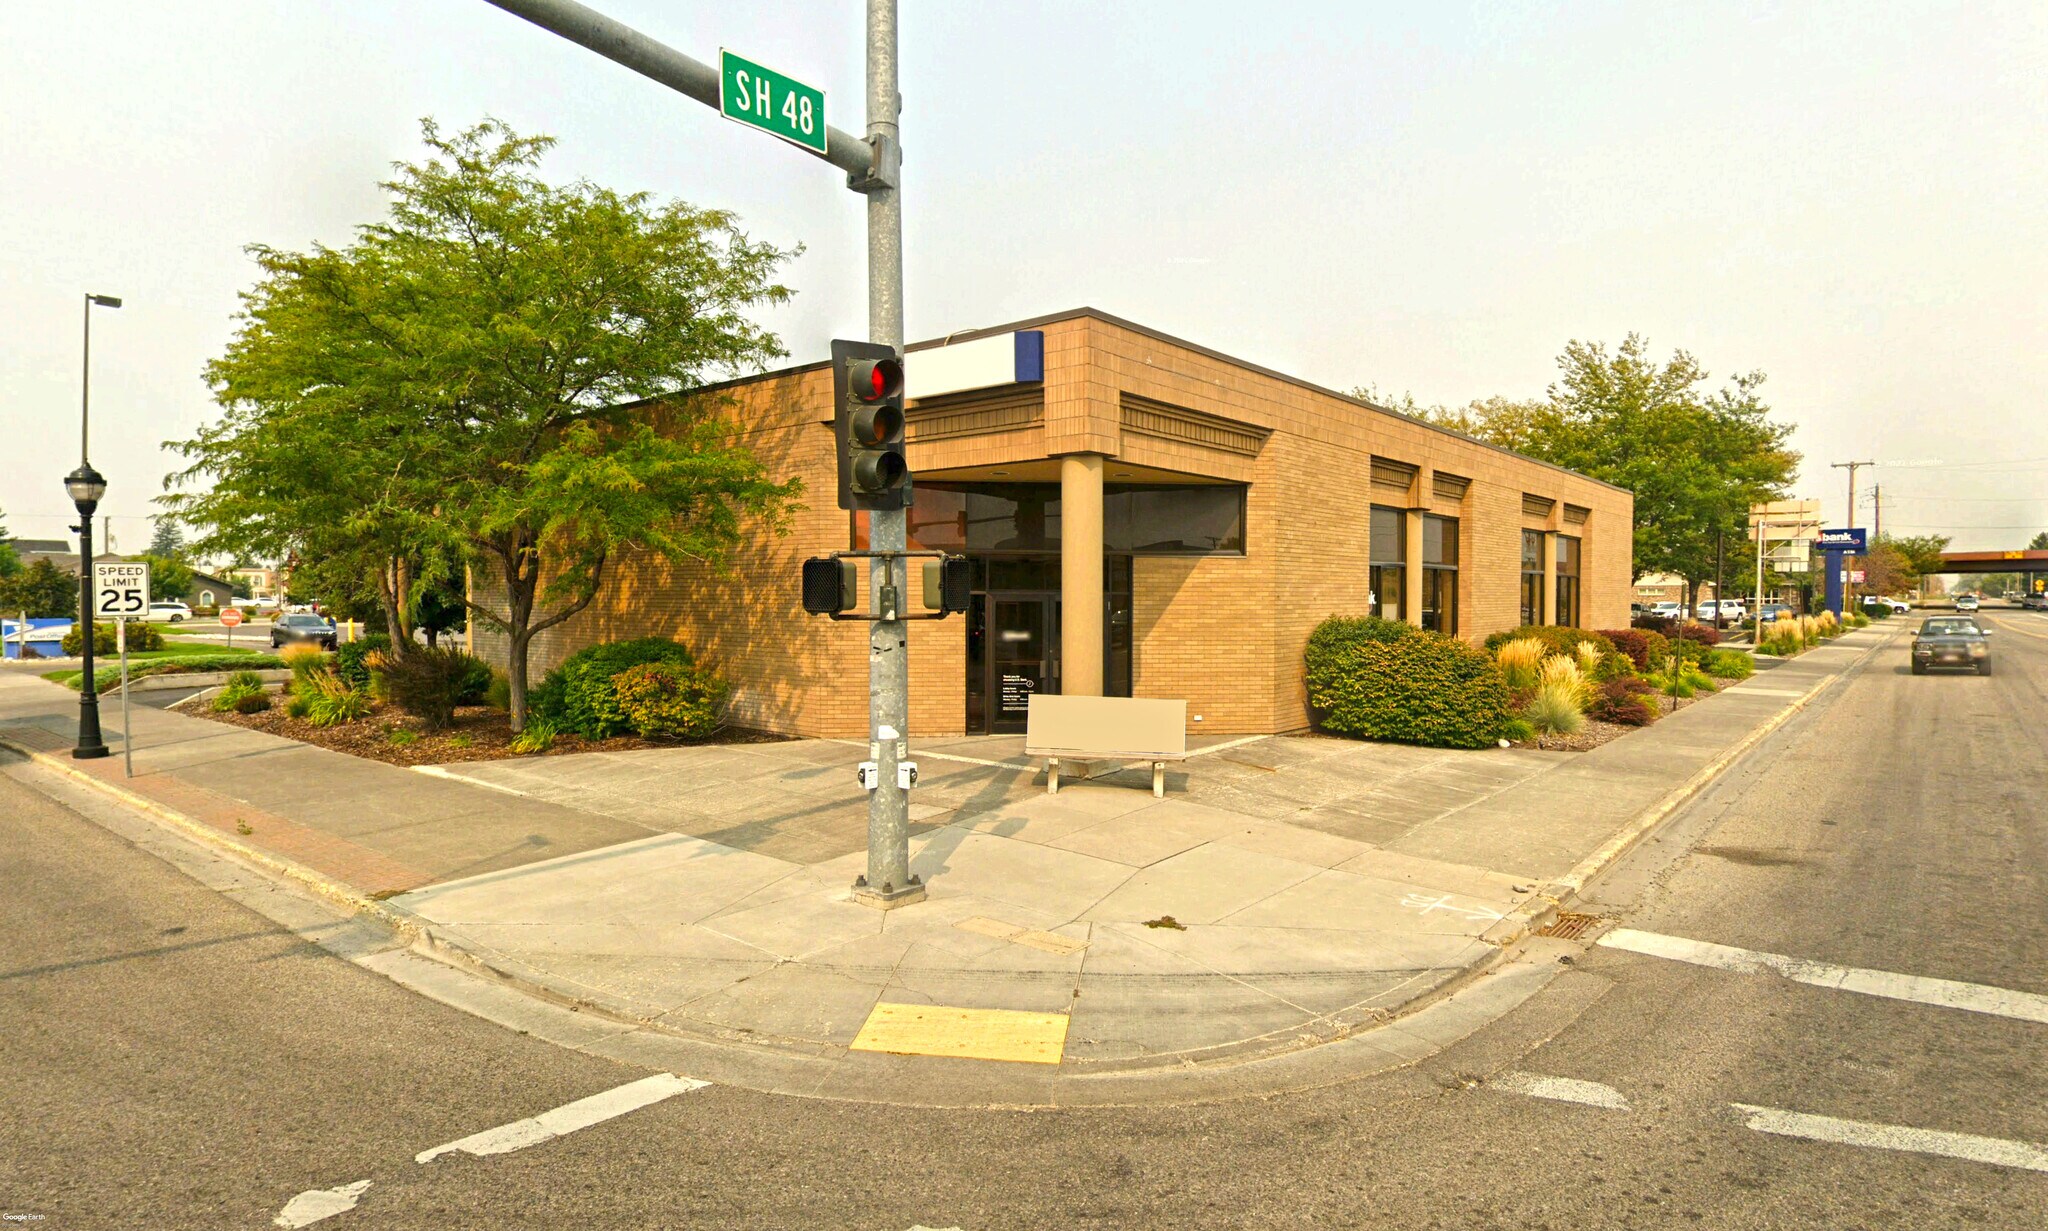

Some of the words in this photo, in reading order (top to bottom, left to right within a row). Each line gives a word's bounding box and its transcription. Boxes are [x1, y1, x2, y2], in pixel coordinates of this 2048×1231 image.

[736, 70, 771, 119] SH
[782, 90, 813, 135] 48
[98, 567, 143, 576] SPEED
[103, 578, 138, 587] LIMIT
[101, 589, 143, 612] 25
